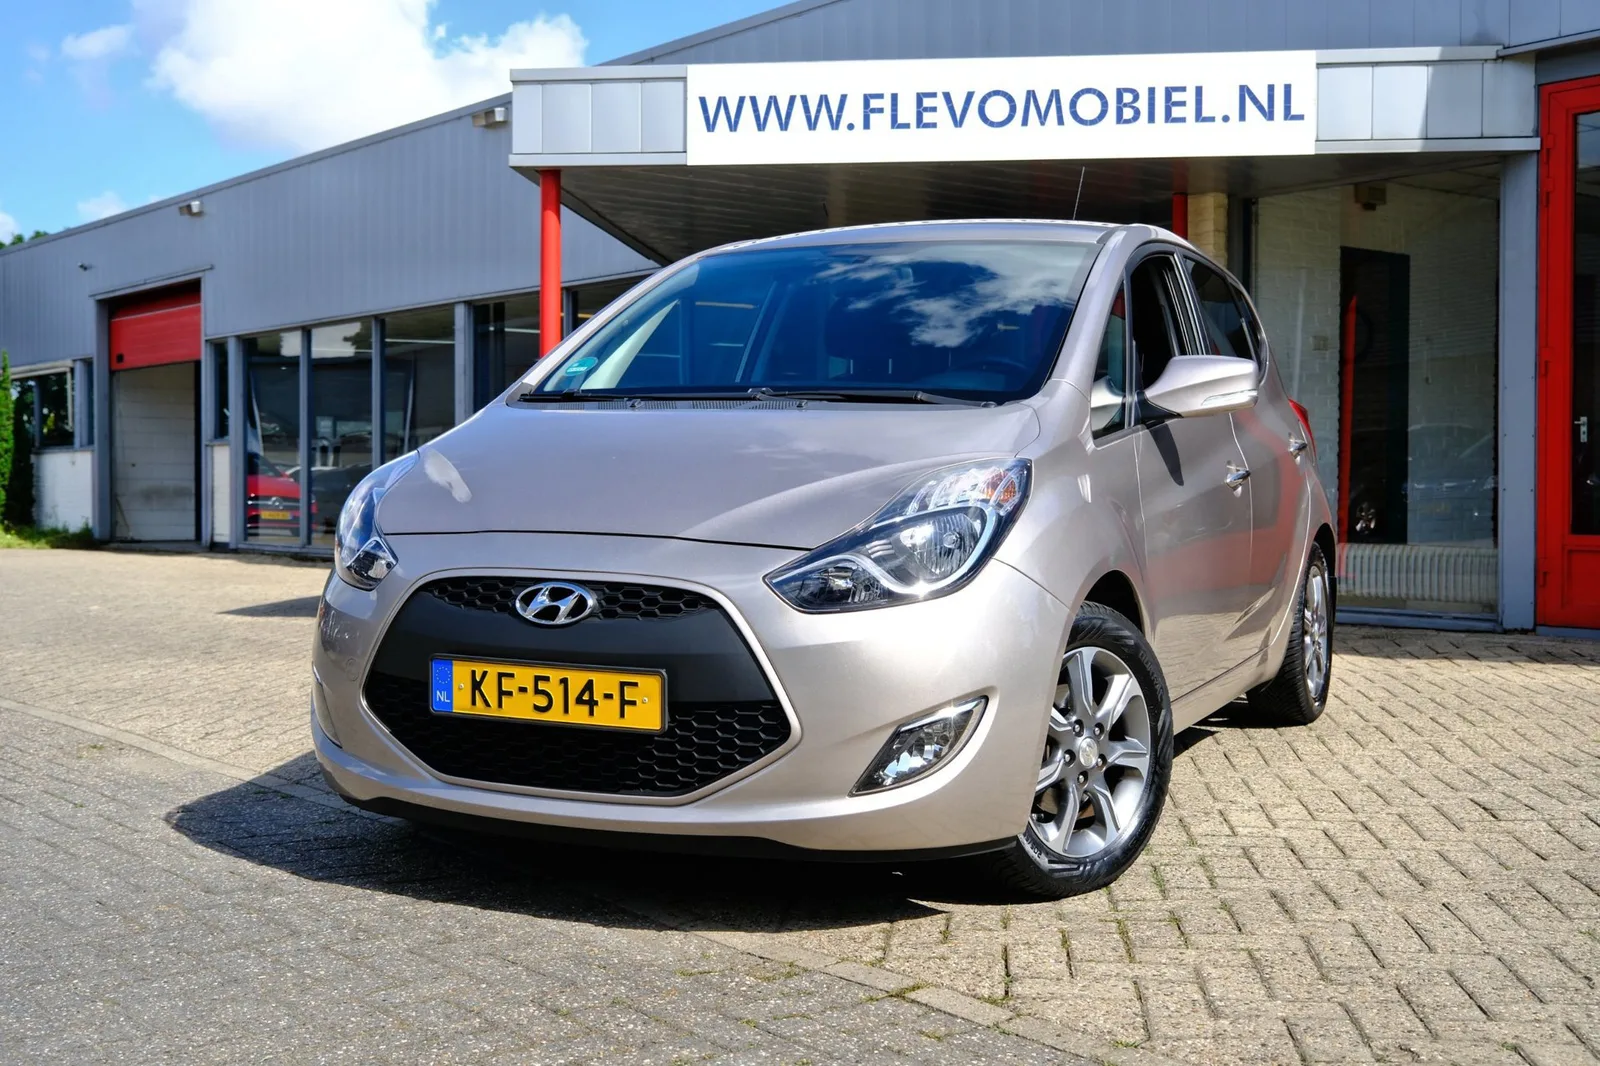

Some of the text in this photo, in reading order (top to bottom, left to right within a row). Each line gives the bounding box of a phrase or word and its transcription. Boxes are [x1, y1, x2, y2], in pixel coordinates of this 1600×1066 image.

[698, 83, 1305, 133] WWW.FLEVOMOBIEL.NL
[436, 690, 451, 703] NL
[470, 669, 639, 719] KF-514-F
